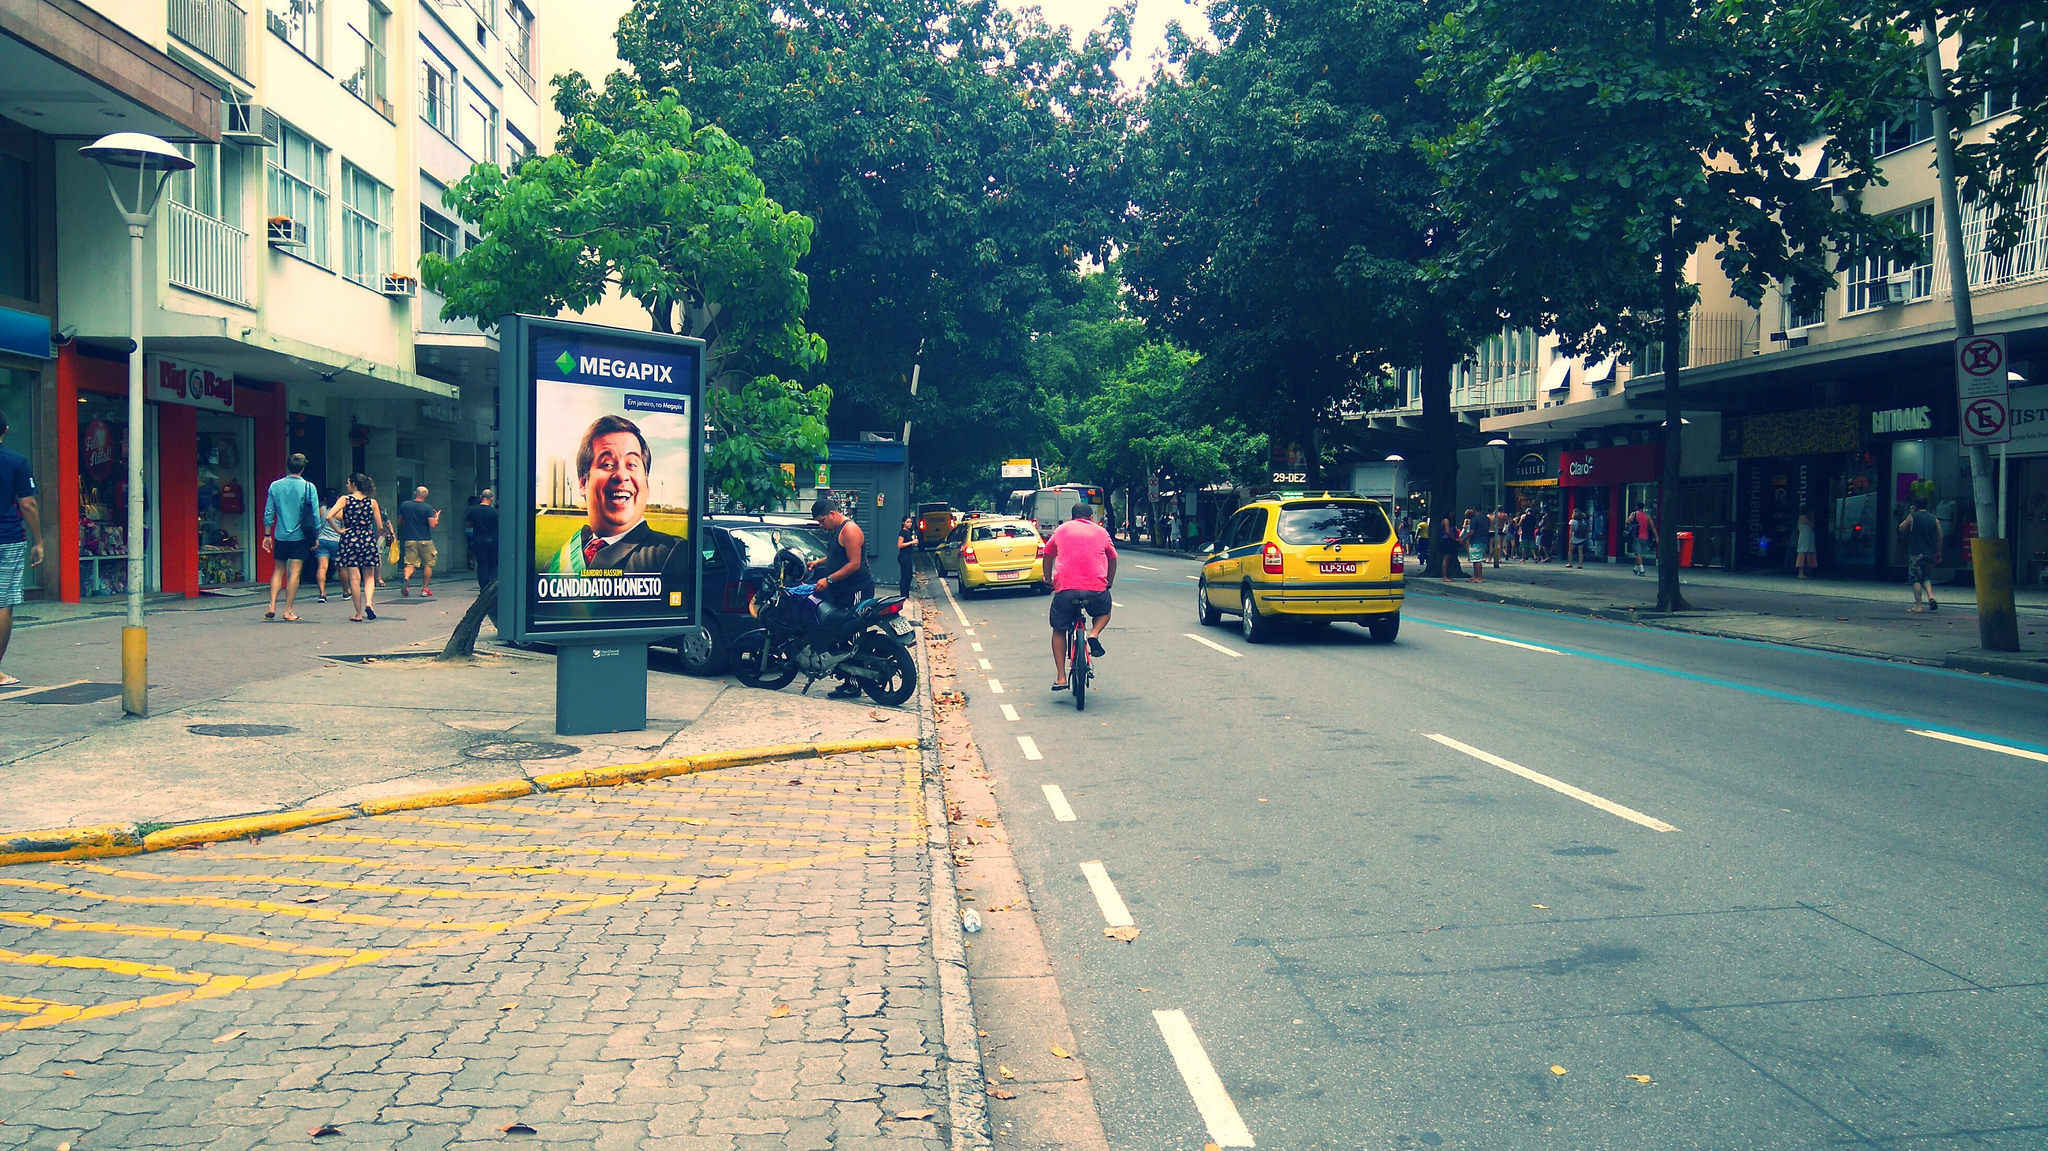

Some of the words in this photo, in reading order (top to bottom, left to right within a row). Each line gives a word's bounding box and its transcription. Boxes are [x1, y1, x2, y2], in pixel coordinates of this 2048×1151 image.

[580, 355, 673, 383] MEGAPIX
[159, 361, 187, 399] Big
[203, 370, 232, 407] Bag
[663, 402, 682, 411] Megapix
[1569, 462, 1589, 476] Claro
[1273, 473, 1306, 483] 29-DEZ
[581, 569, 603, 577] LEANDRO
[603, 569, 623, 577] HASSUM
[1320, 564, 1356, 574] LLP-2140
[538, 578, 548, 598] O
[549, 578, 612, 598] CANDIDATO
[613, 577, 662, 596] HONESTO
